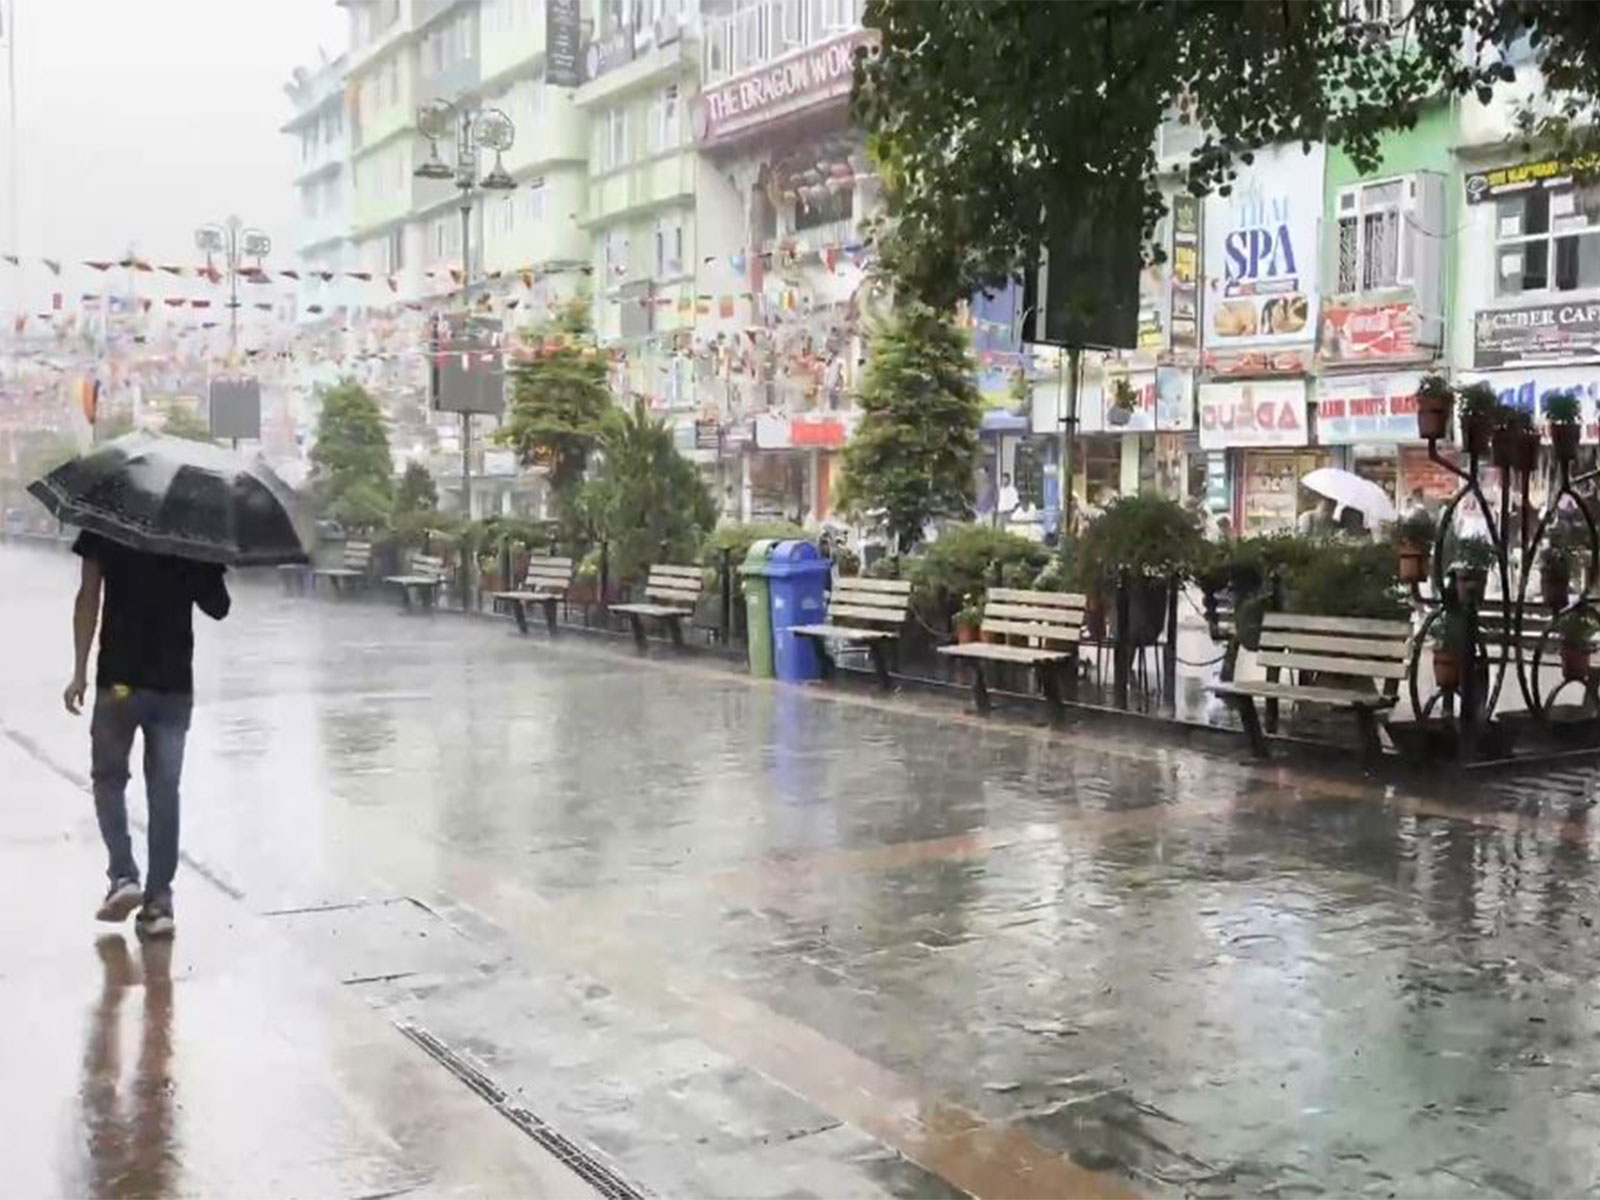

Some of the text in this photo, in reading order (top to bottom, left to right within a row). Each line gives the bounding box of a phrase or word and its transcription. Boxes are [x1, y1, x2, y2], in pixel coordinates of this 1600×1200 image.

[707, 41, 856, 121] THE DRAGON WOK
[1224, 223, 1297, 280] SPA
[1559, 305, 1600, 324] CAF
